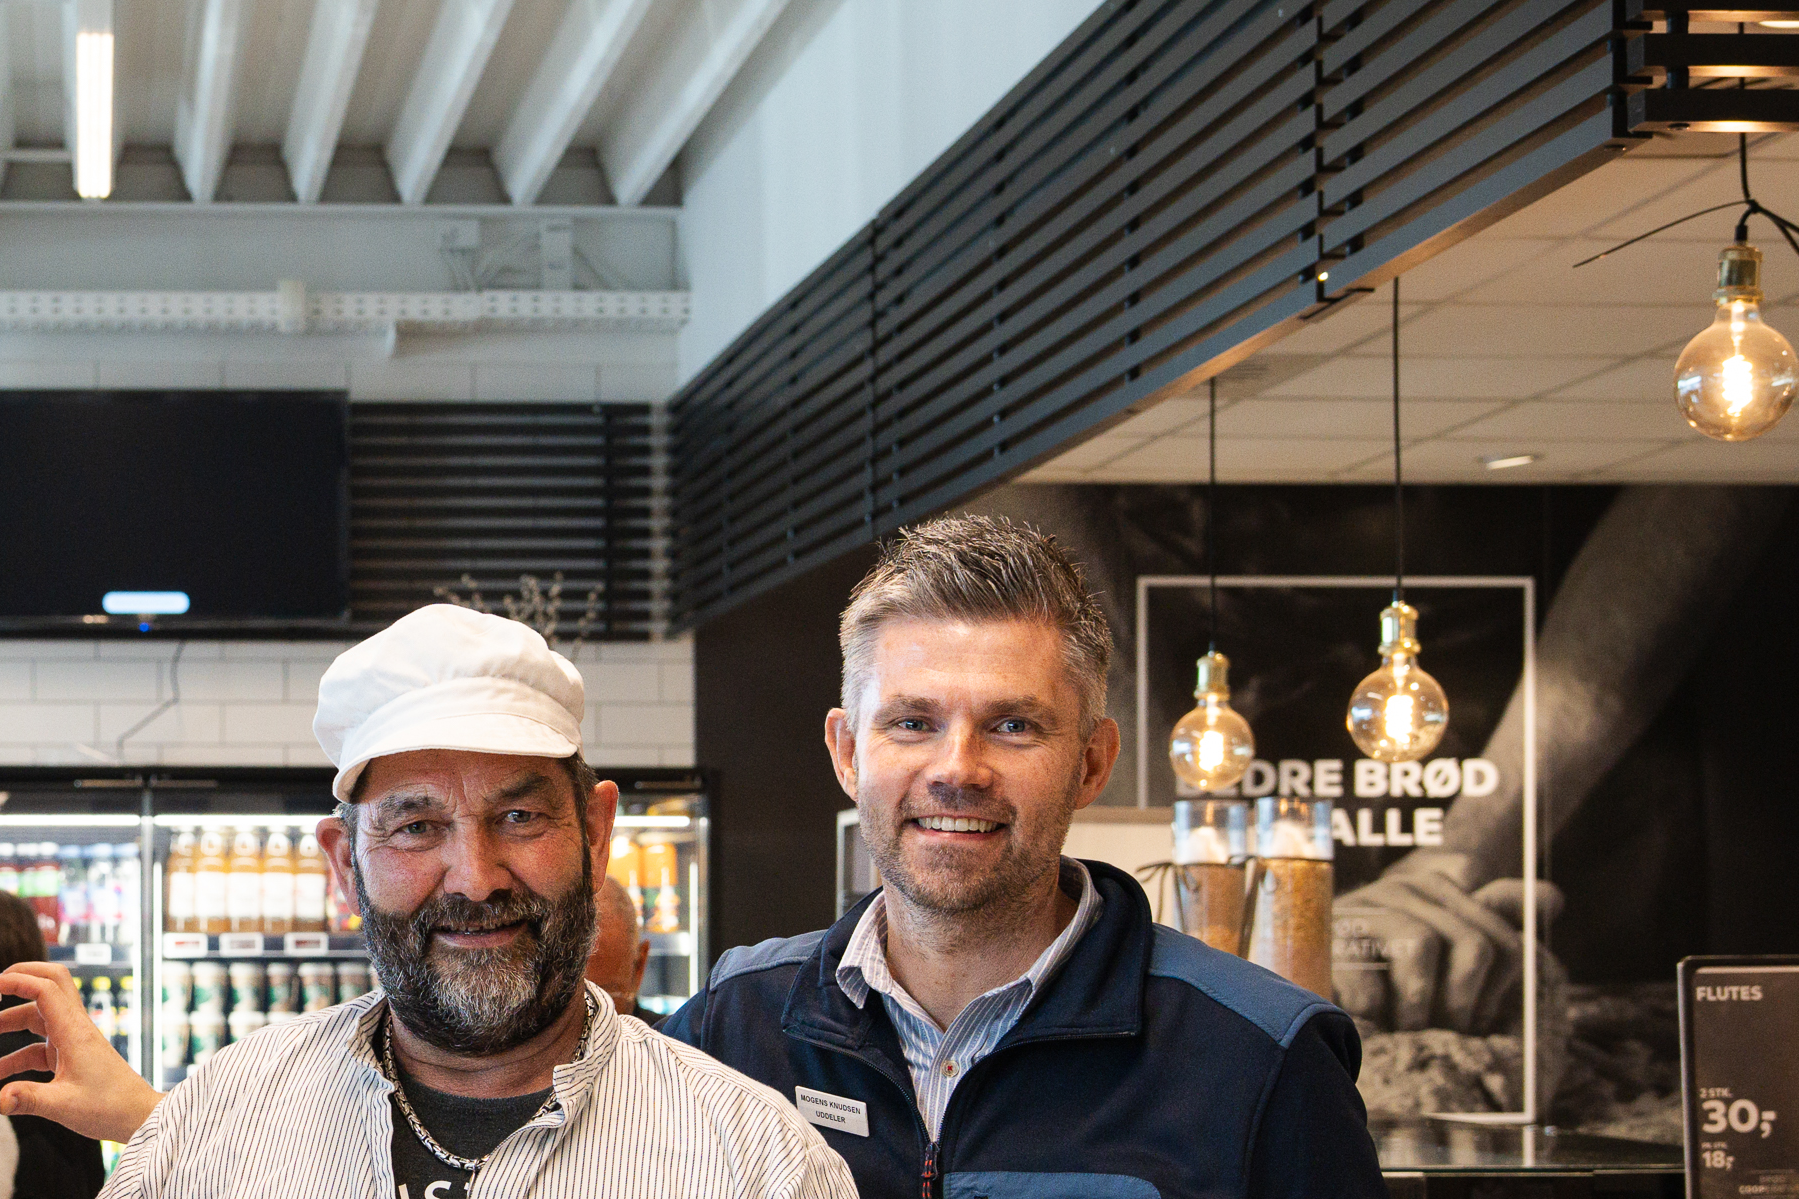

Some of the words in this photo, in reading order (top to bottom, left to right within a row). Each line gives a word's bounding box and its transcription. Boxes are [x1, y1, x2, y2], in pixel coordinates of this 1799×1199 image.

[1175, 758, 1345, 798] DRE
[1354, 757, 1500, 799] BRØD
[1331, 808, 1445, 846] ALLE
[1696, 985, 1763, 1001] FLUTES
[800, 1094, 828, 1107] MOGENS
[829, 1101, 861, 1115] KNUDSEN
[815, 1110, 846, 1123] UDDELER
